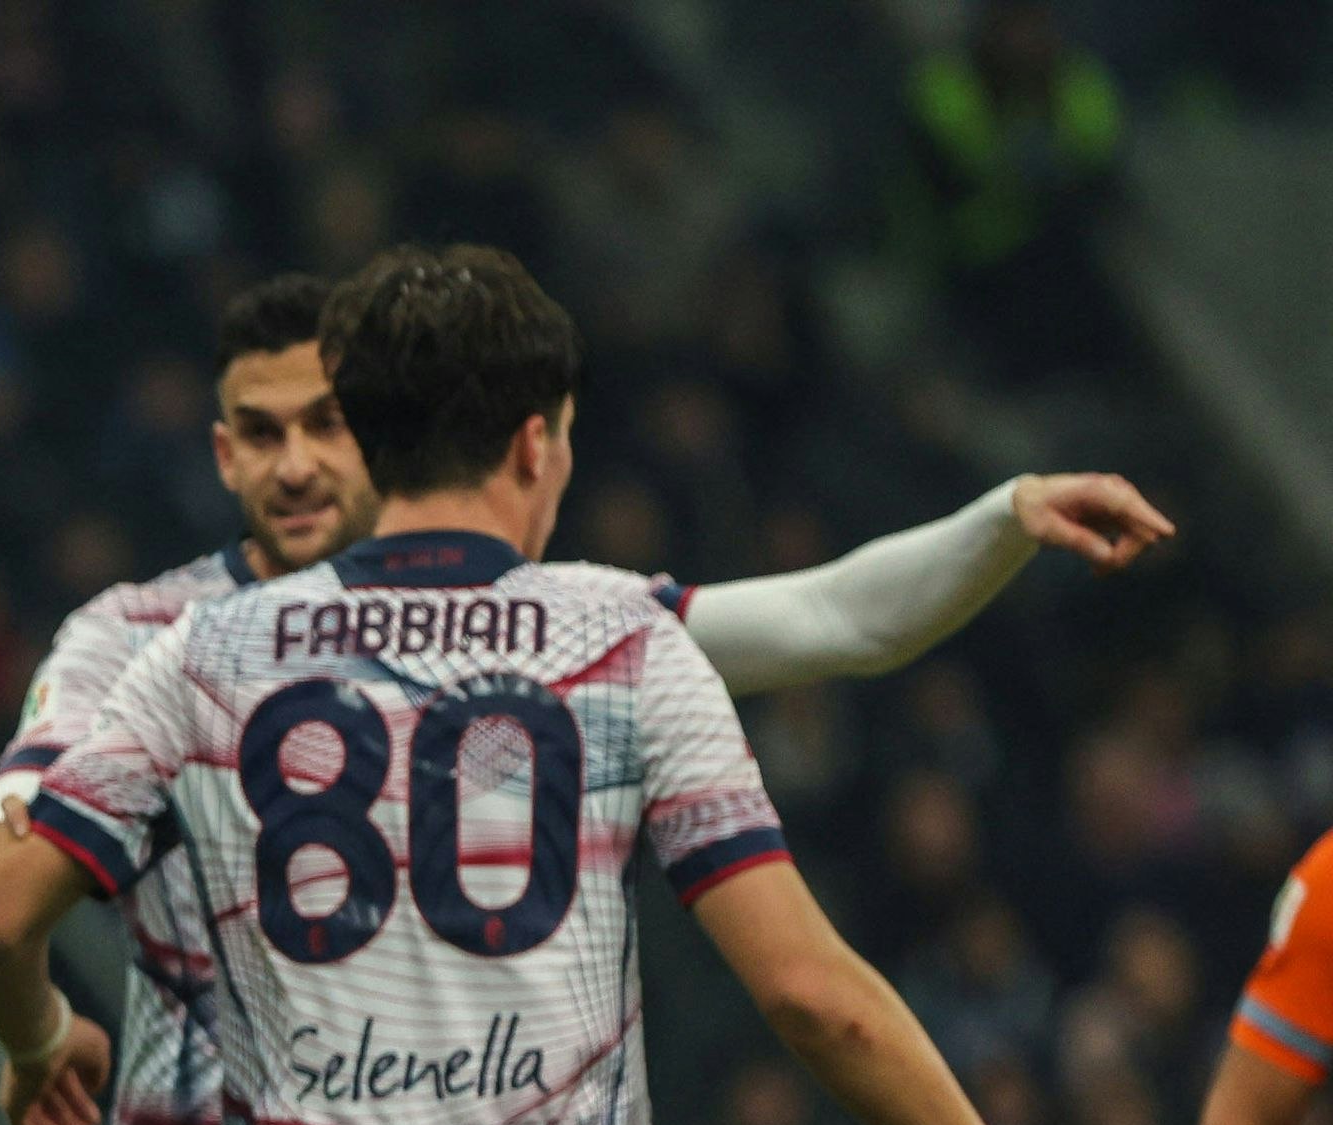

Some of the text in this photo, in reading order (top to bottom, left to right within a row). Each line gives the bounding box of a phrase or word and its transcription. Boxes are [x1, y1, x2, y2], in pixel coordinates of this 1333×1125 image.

[273, 599, 548, 660] FABBIAN
[240, 673, 584, 965] 80
[290, 1014, 551, 1101] Selenella
